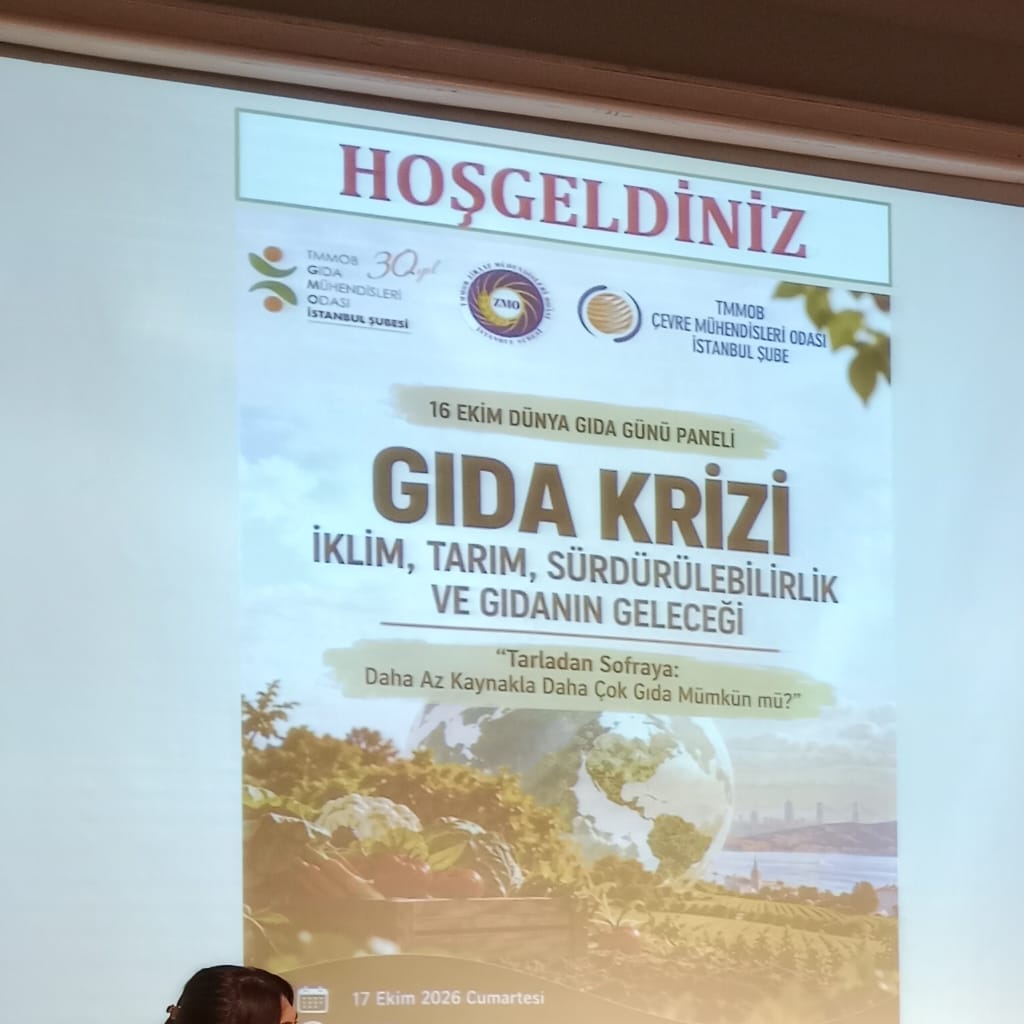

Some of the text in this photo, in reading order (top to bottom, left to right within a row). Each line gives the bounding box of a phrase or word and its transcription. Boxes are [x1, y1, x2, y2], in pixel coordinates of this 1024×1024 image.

[339, 143, 807, 258] HOŞGELDİNİZ
[307, 250, 359, 266] TMMOB
[307, 265, 342, 278] GIDA
[307, 294, 350, 308] ODASI
[715, 299, 765, 320] TMMOB
[307, 306, 409, 329] İSTANBUL ŞUBESİ
[651, 312, 827, 348] ÇEVRE MÜHENDİSLERİ ODASI
[692, 335, 790, 364] İSTANBUL ŞUBE
[429, 400, 736, 449] 16 EKİM DÜNYA GIDA GÜNÜ PANELİ
[372, 445, 791, 557] GIDA KRİZİ
[312, 525, 840, 605] İKLİM, TARIM, SÜRDÜRÜLEBİLİRLİK
[431, 583, 745, 636] VE GIDANIN GELECEĞİ
[600, 655, 679, 680] Sofraya:
[365, 667, 413, 690] Daha
[420, 671, 444, 690] Az
[451, 672, 537, 698] Kaynakla
[543, 677, 588, 698] Daha
[594, 679, 629, 703] Çok
[633, 682, 672, 702] Gıda
[678, 685, 752, 709] Mümkün
[352, 990, 545, 1007] 17 Ekim 2026 Cumartesi
